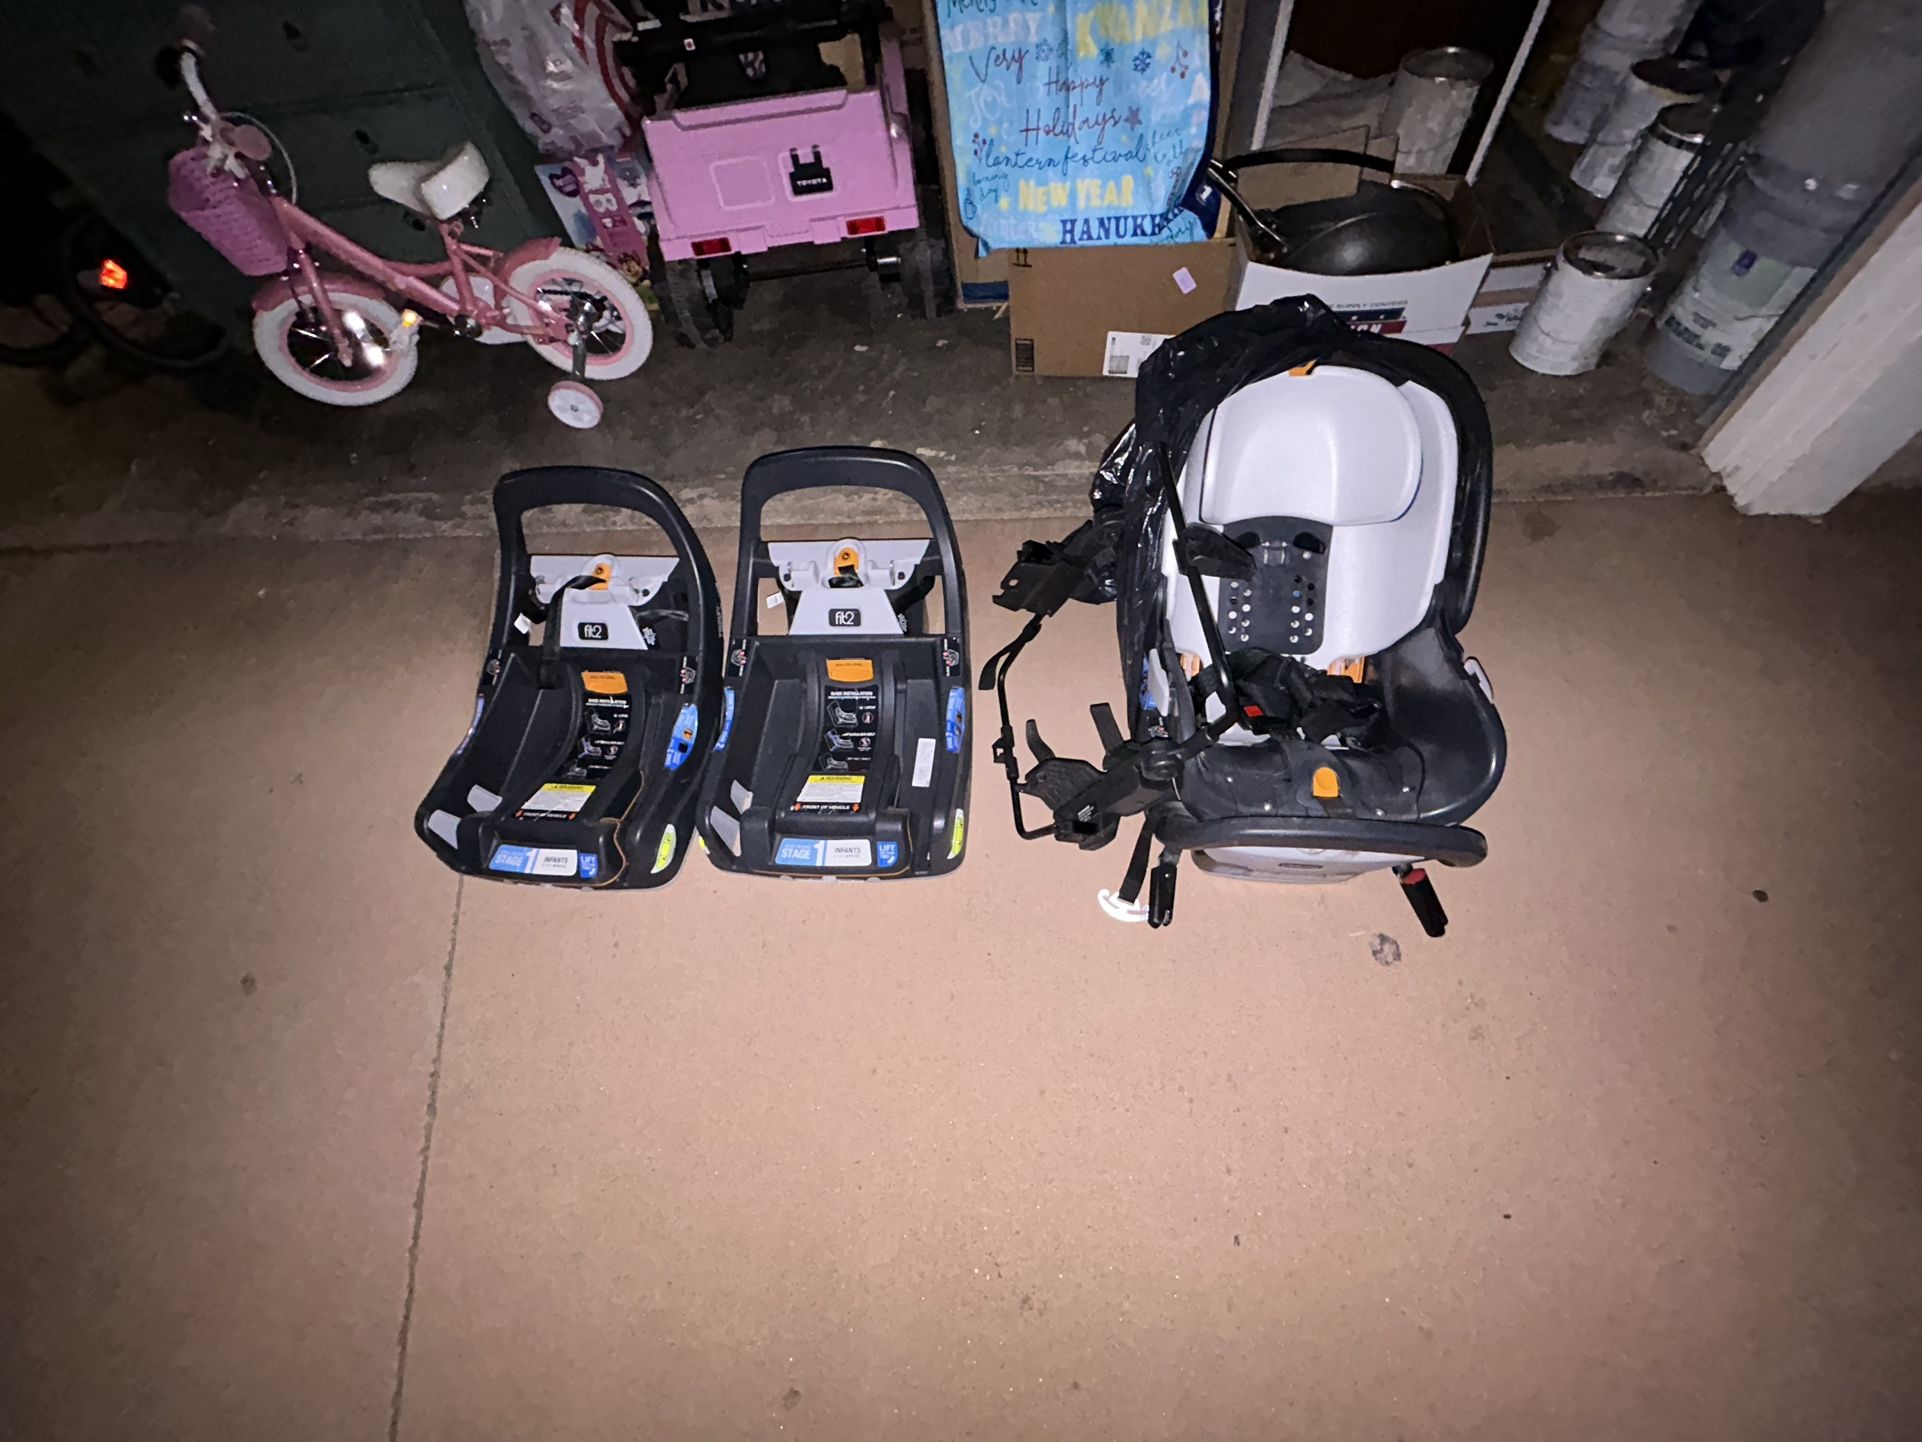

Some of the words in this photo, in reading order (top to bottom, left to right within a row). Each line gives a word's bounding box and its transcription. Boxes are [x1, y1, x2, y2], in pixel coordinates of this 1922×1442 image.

[968, 46, 1030, 85] Very
[1043, 67, 1109, 105] Happy
[1020, 103, 1123, 147] Holidays
[984, 139, 1062, 170] lantern
[1058, 134, 1149, 176] festival
[796, 177, 828, 187] TOYOTA
[1019, 177, 1070, 214] NEW
[1077, 175, 1134, 210] YEAR
[834, 611, 855, 625] fit2
[583, 624, 603, 639] fit2
[781, 847, 812, 860] STAGE
[834, 846, 862, 854] INFANTS
[879, 844, 895, 852] LIFT
